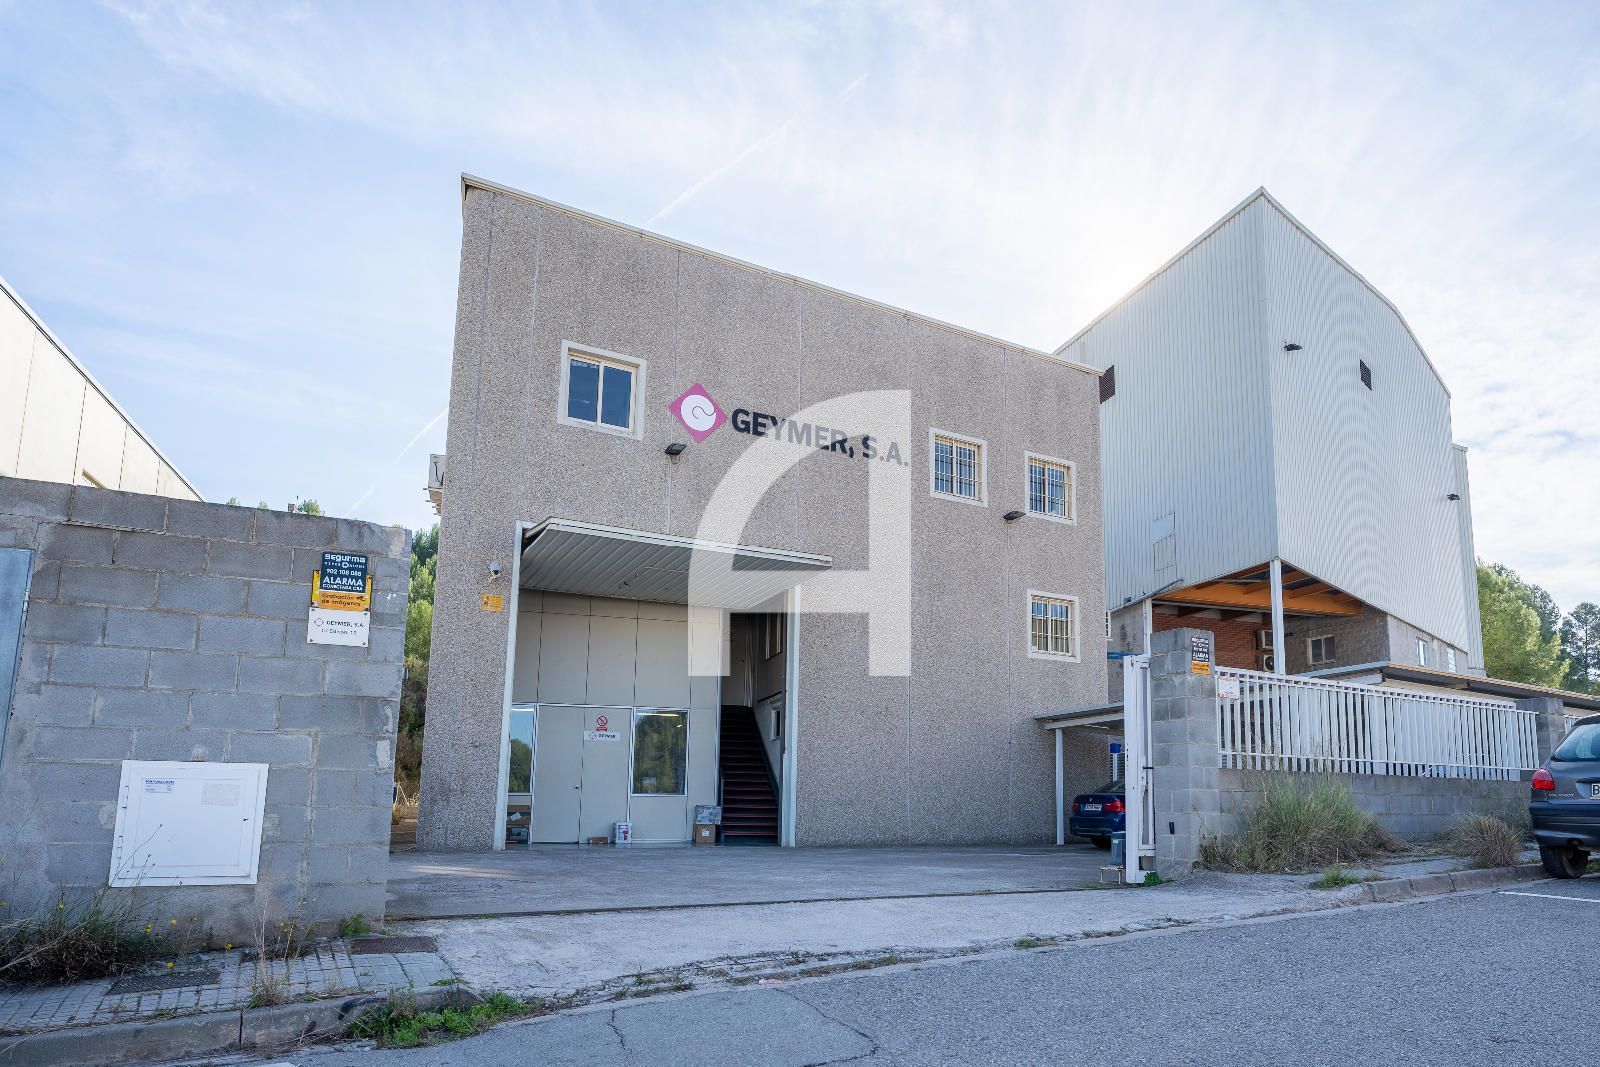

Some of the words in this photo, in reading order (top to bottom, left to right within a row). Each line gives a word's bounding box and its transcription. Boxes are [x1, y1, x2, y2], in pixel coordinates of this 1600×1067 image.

[732, 408, 854, 459] GEYMER,
[861, 434, 909, 467] S.A.
[325, 553, 366, 563] segurma
[323, 576, 363, 587] ALARMA
[321, 592, 355, 600] Grabación
